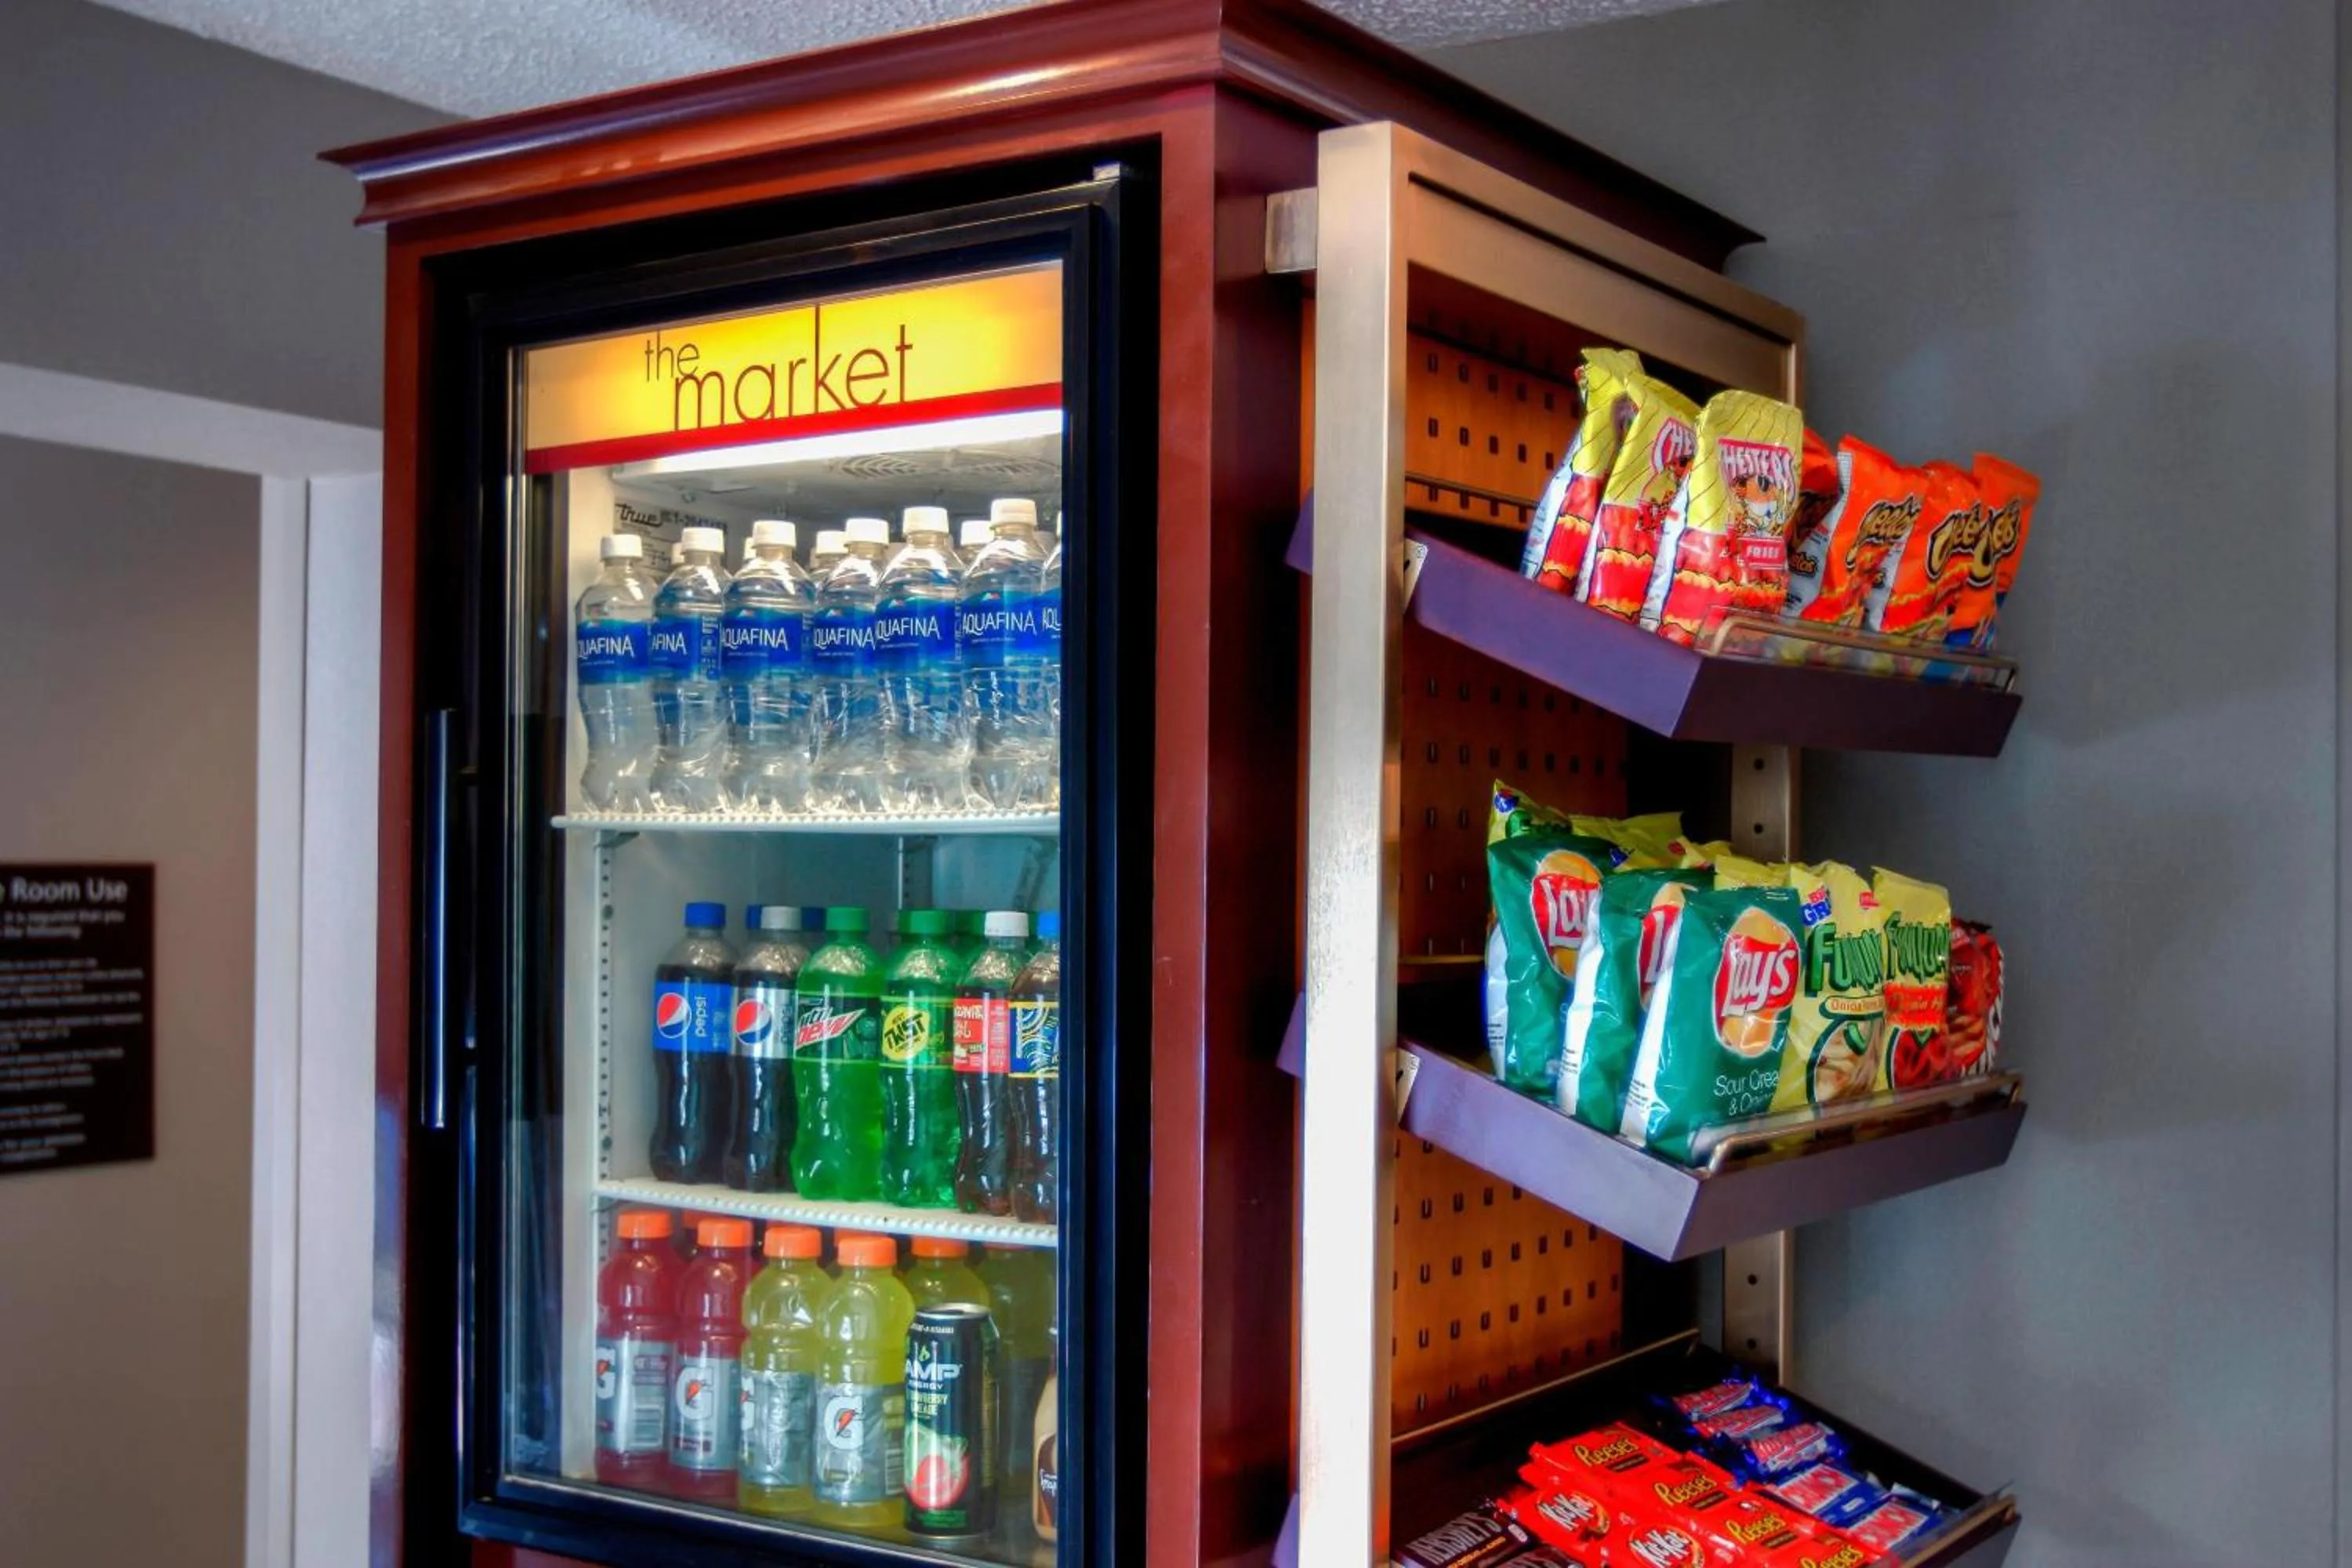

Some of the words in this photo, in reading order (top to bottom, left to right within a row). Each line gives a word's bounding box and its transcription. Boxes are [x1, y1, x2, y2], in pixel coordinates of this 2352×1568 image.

[643, 328, 701, 382] the
[673, 304, 913, 431] market
[10, 876, 81, 902] Room
[85, 877, 128, 902] Use
[1722, 940, 1795, 1017] Lay's
[695, 996, 709, 1038] pepsi
[1713, 1075, 1747, 1096] Sour
[1729, 1098, 1738, 1116] &
[906, 1360, 961, 1381] AMP
